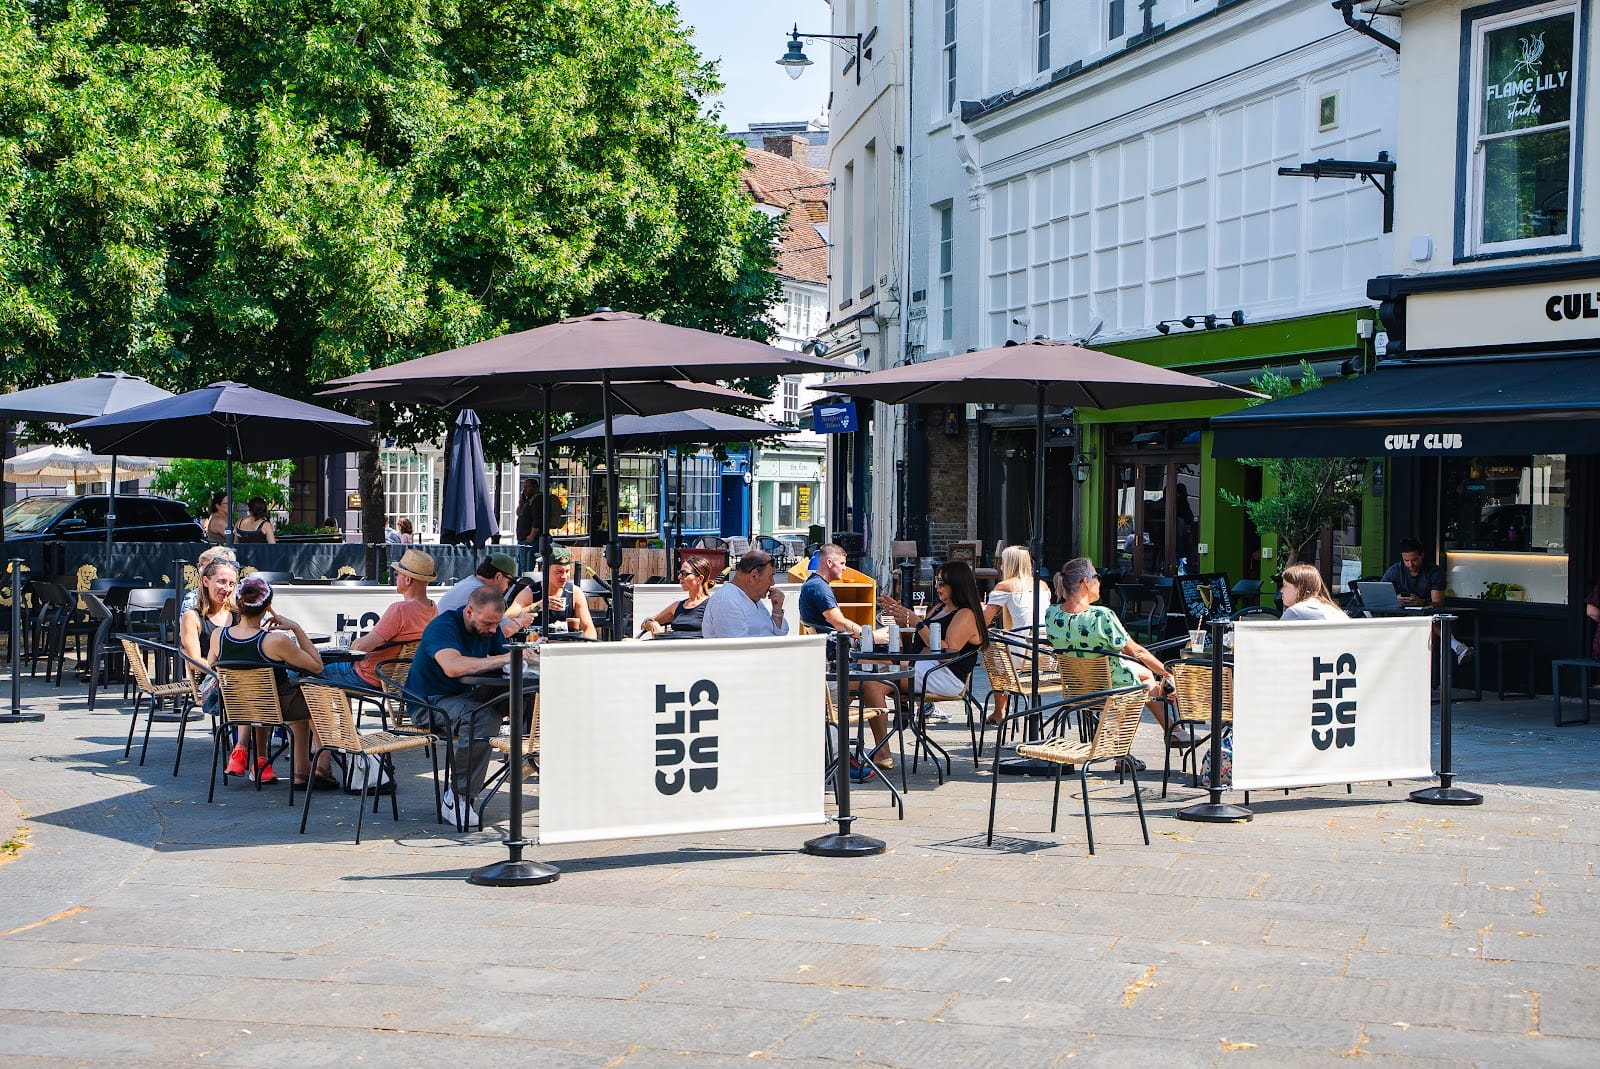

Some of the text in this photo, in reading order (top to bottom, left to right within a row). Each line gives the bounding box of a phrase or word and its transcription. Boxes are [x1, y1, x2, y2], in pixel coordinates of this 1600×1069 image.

[1487, 71, 1569, 101] FLAME LILY
[1507, 94, 1542, 124] studio
[1545, 291, 1600, 322] CUL
[1384, 433, 1463, 450] CULT CLUB
[1311, 656, 1334, 751] CULT
[1335, 652, 1357, 749] CLUB
[654, 683, 686, 796] CULT
[688, 678, 720, 794] CLUB
